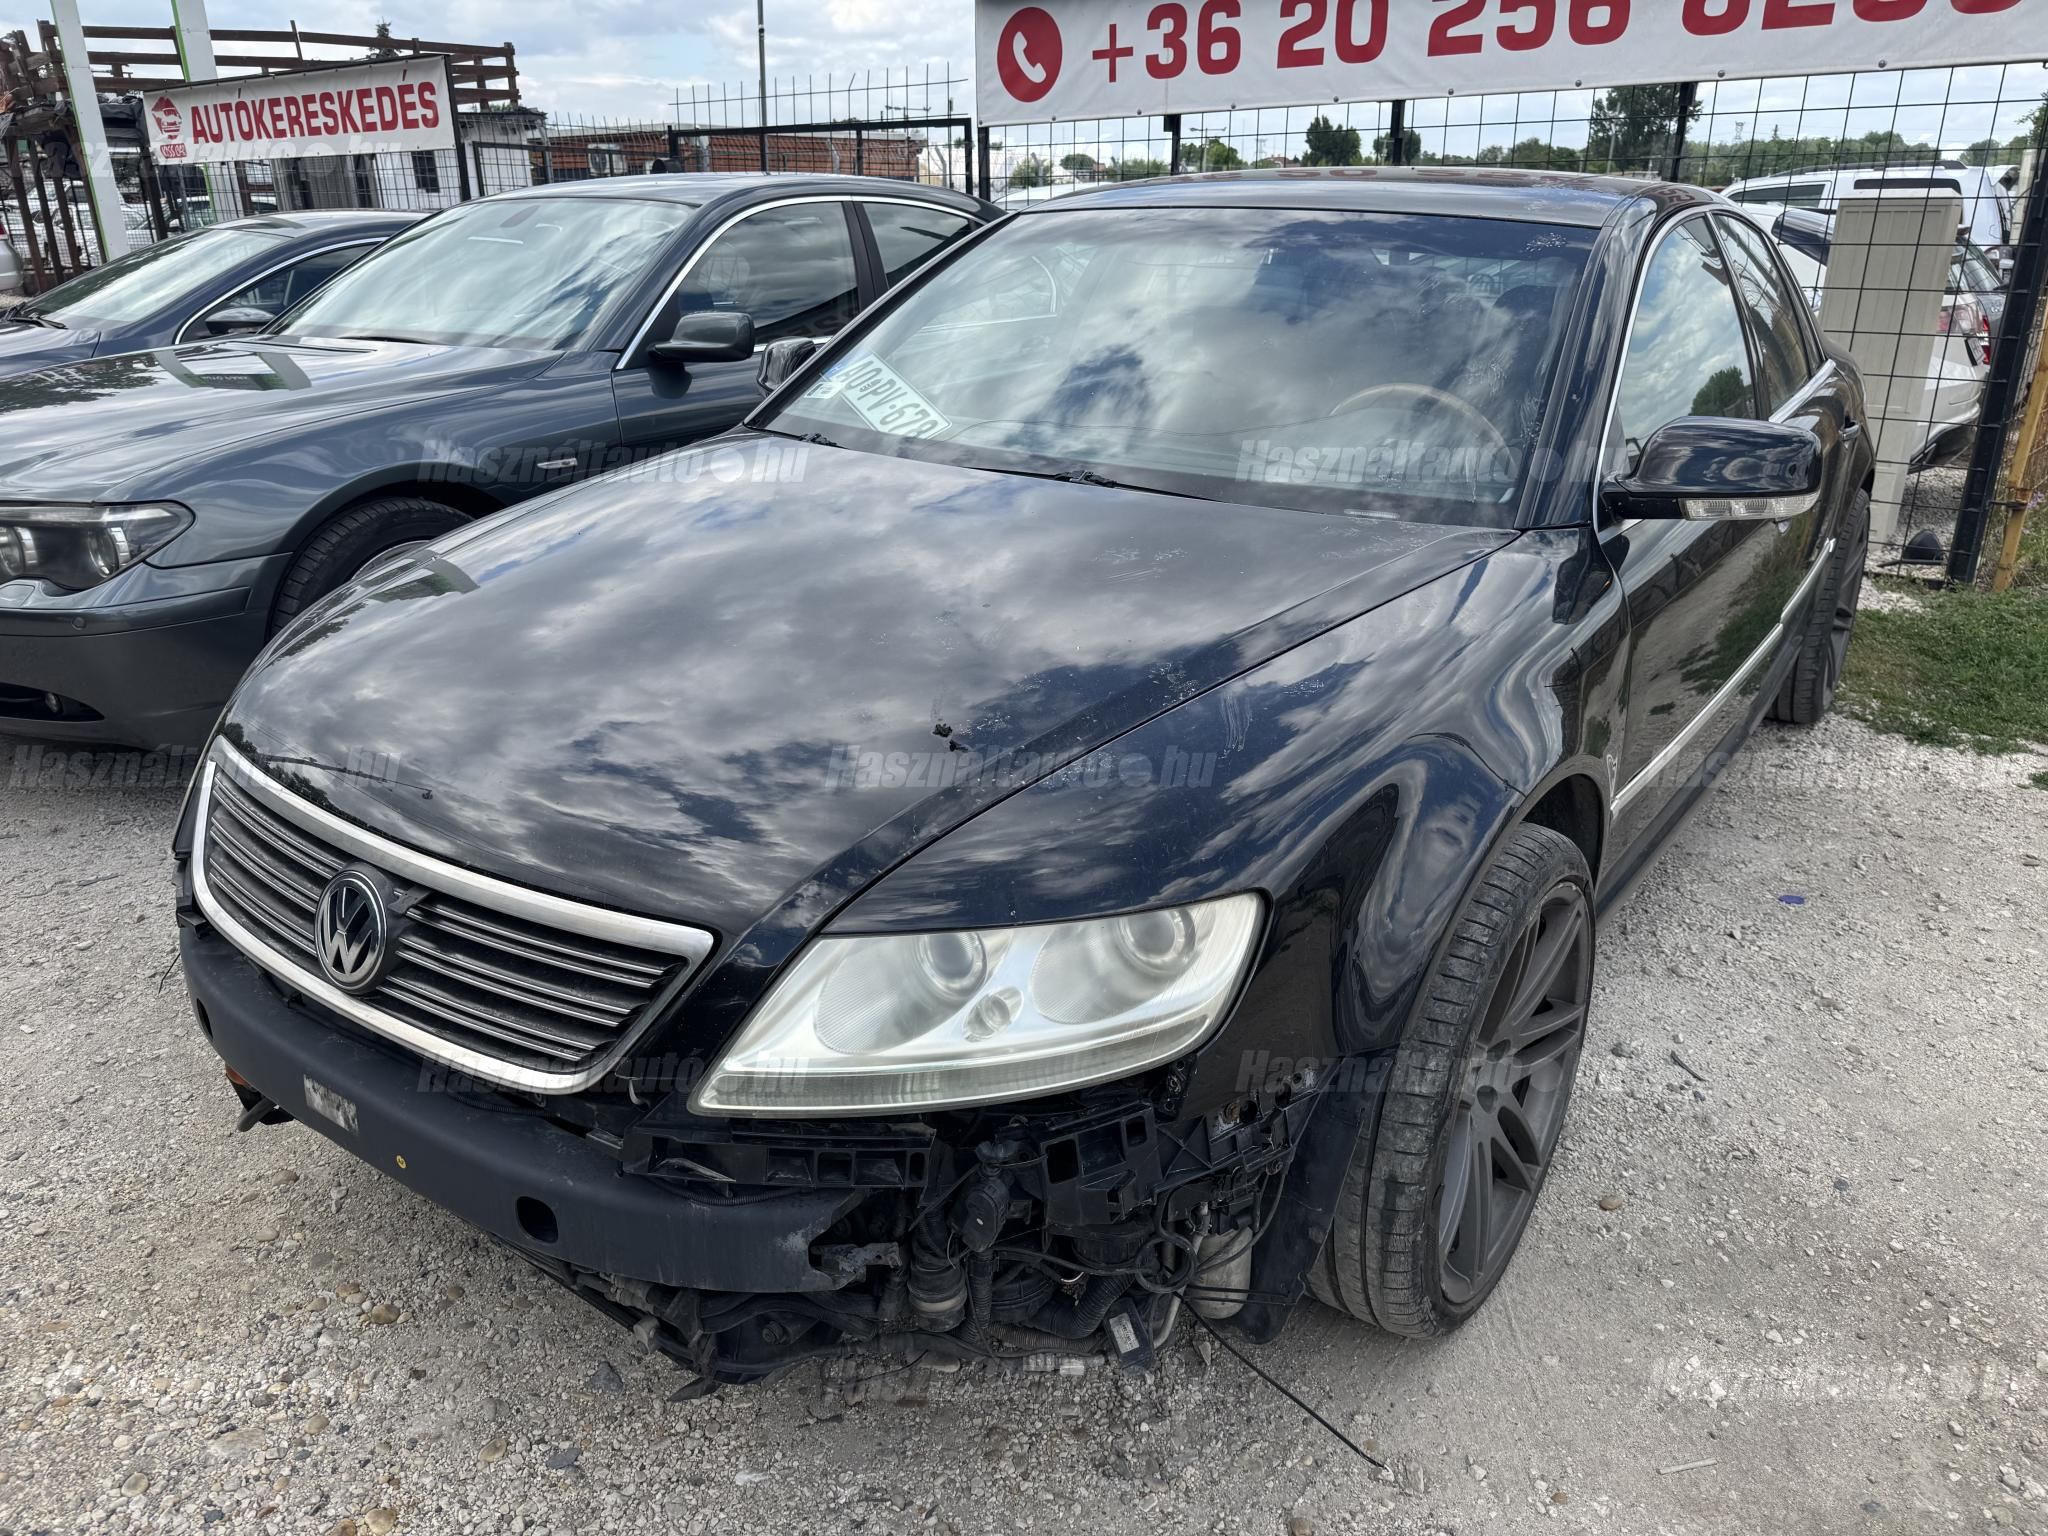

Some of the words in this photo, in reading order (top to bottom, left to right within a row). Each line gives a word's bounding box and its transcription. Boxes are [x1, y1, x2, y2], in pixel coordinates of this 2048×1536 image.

[1092, 0, 1242, 82] +36
[1277, 0, 1388, 68] 20
[190, 69, 440, 145] AUTÓKERESKEDÉS
